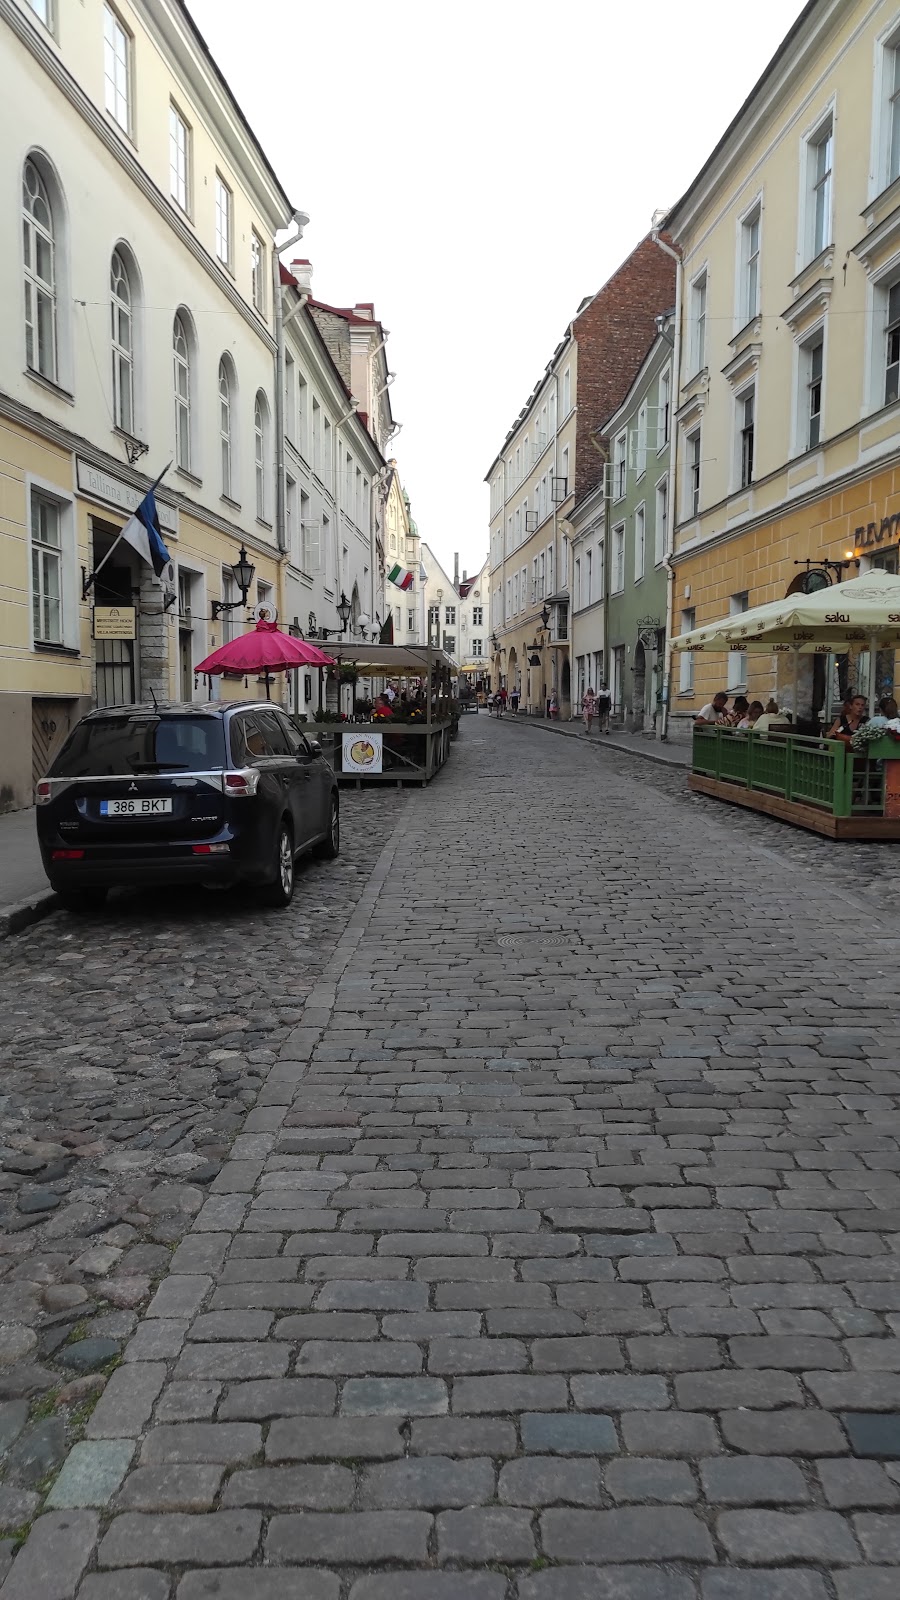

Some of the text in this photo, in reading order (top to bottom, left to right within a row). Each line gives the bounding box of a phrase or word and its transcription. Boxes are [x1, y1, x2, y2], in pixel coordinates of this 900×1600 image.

[87, 470, 121, 501] Tallinna
[825, 612, 850, 623] saku
[113, 799, 168, 813] 386 BKT
